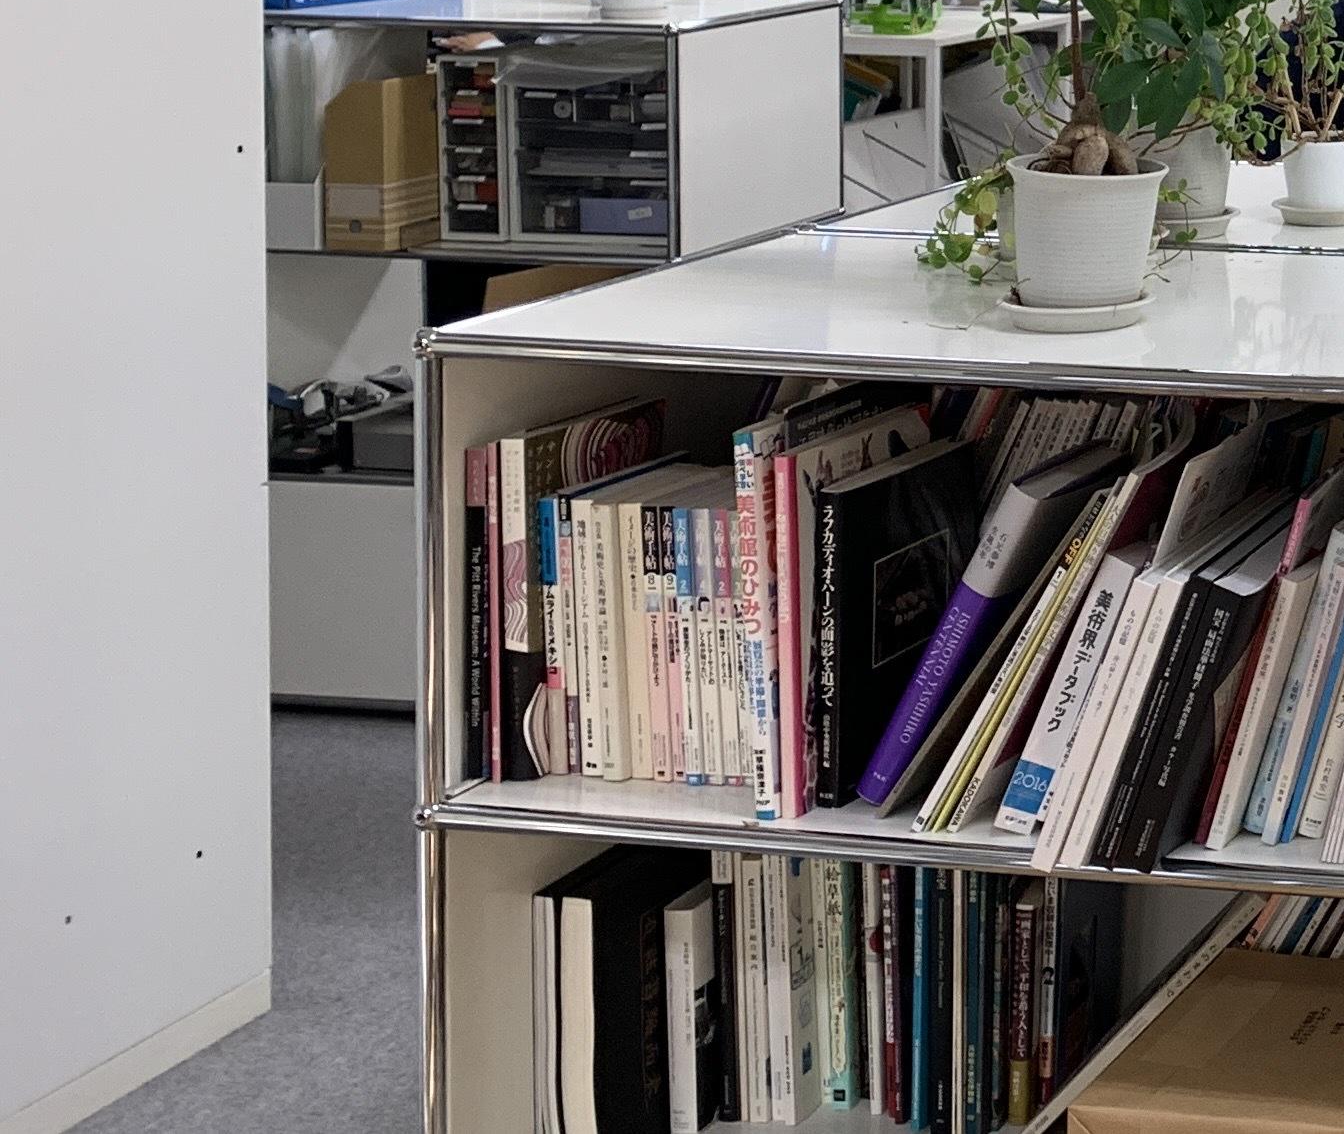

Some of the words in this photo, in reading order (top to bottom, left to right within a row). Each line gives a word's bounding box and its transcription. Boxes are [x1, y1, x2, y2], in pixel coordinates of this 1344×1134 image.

[472, 546, 482, 564] The
[736, 494, 761, 634] 美術館のひみつ
[1064, 536, 1083, 567] OFF
[915, 605, 961, 687] CENTENNIAL
[933, 611, 971, 677] ISHIMOTO
[900, 679, 939, 744] YASUHIRO
[950, 776, 982, 827] KADOKAWA
[1013, 769, 1049, 794] 2016
